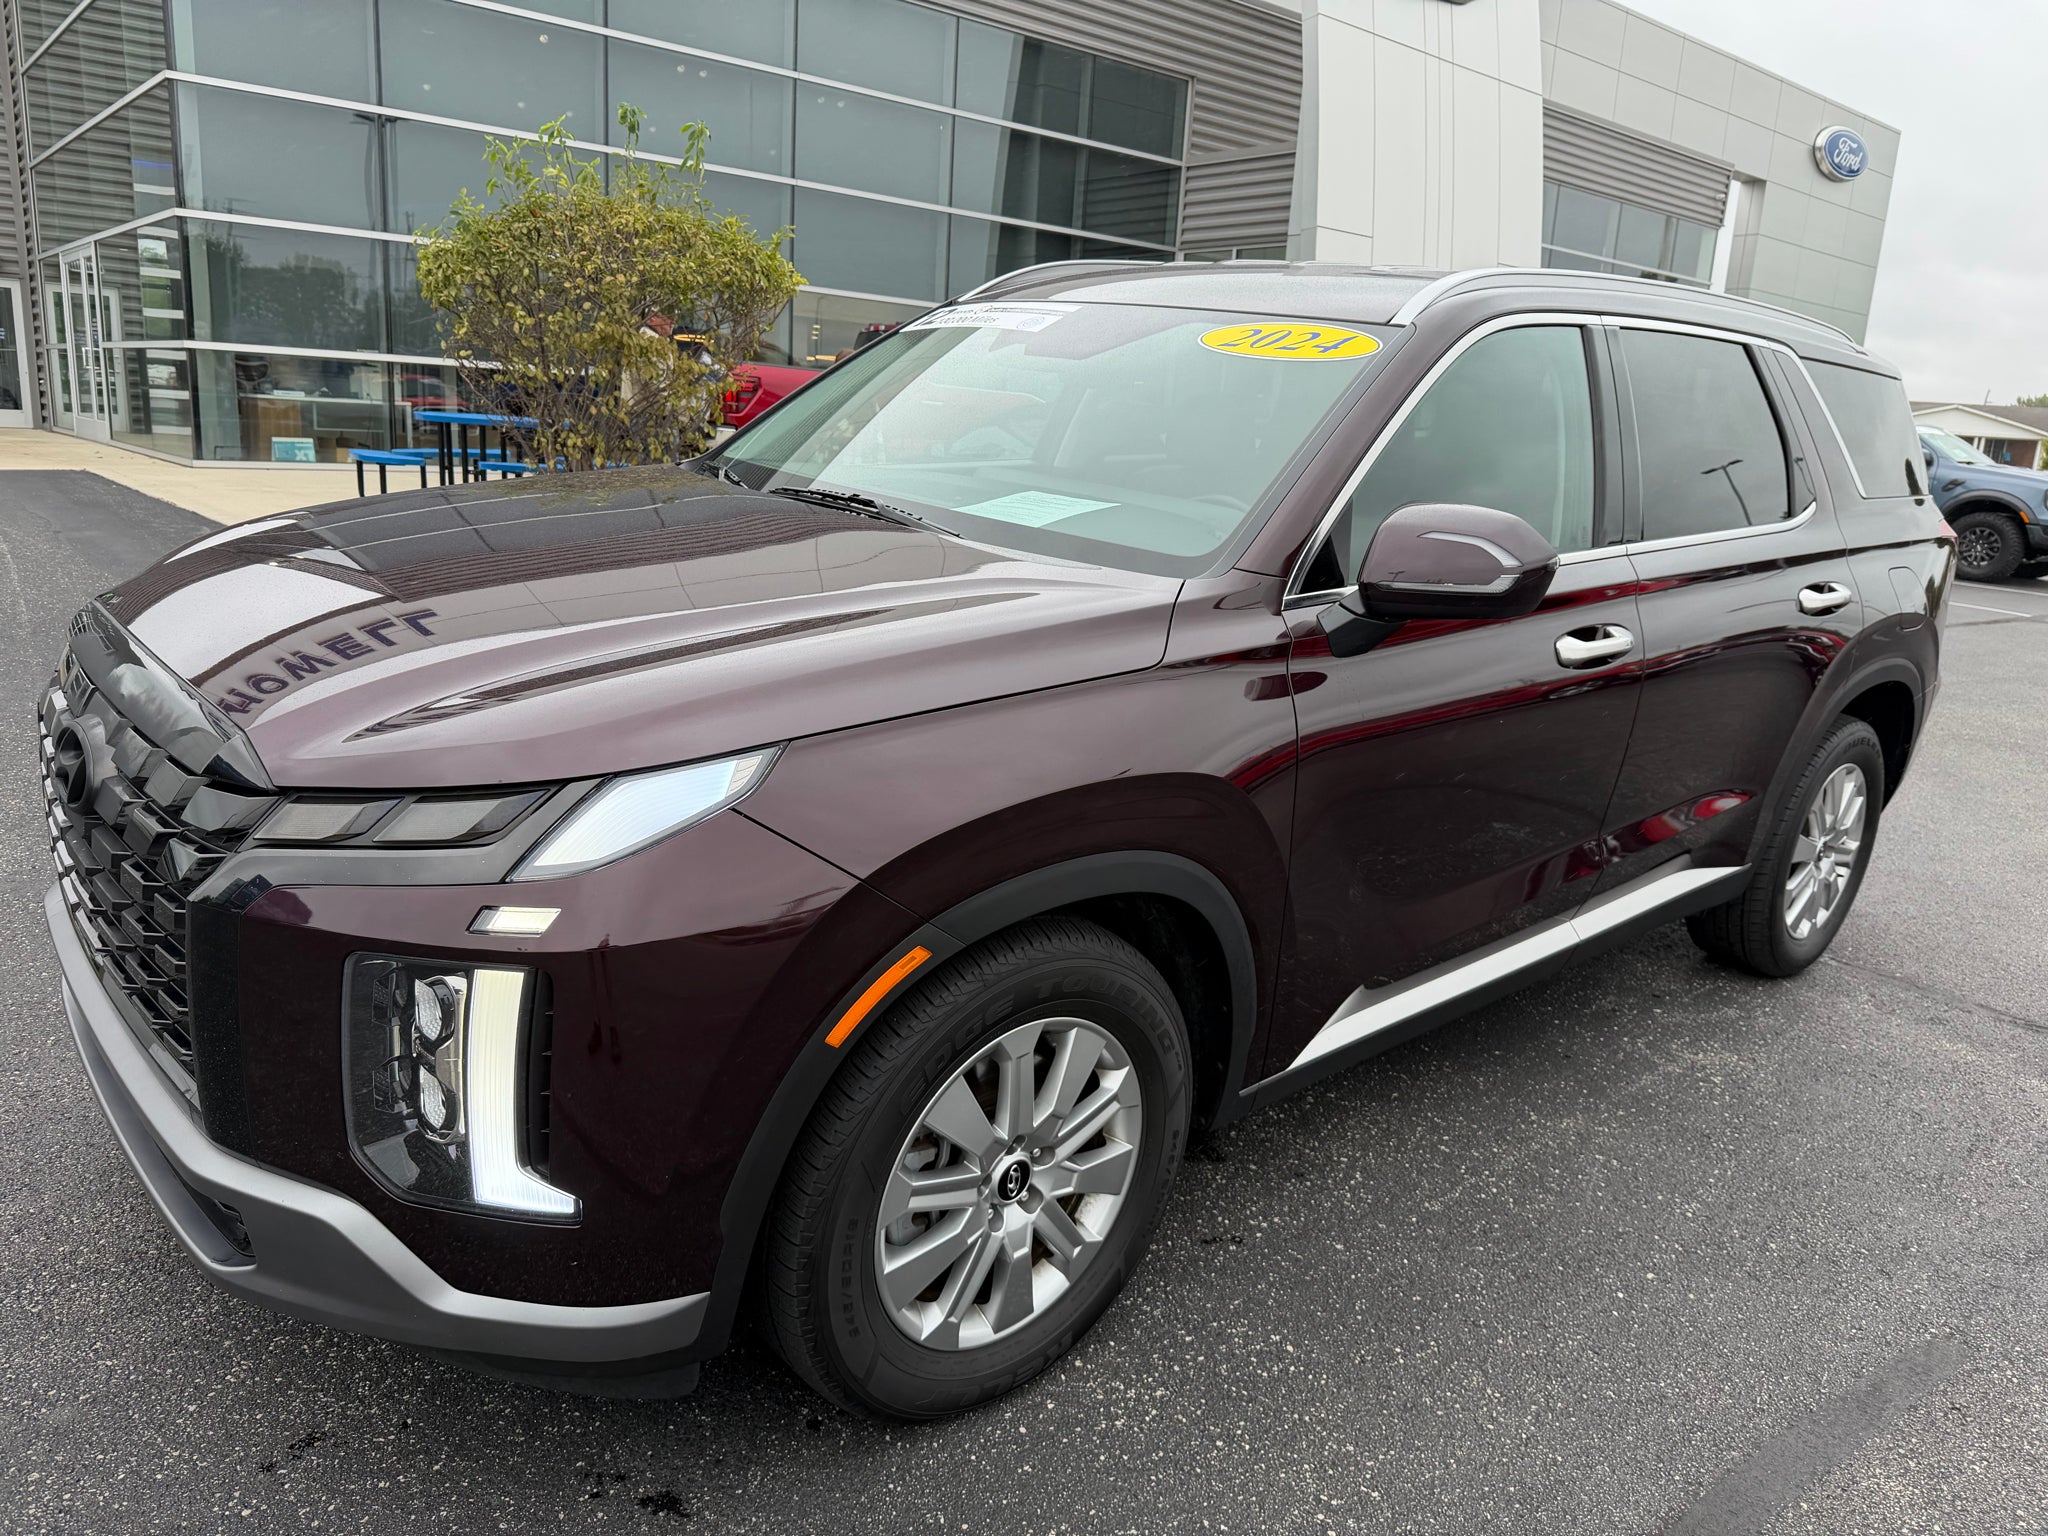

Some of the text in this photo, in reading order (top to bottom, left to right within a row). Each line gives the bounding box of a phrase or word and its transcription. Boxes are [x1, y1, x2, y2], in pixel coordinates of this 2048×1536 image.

[1834, 137, 1863, 171] Ford
[1217, 328, 1360, 354] 2024
[1034, 974, 1175, 1056] TOURING
